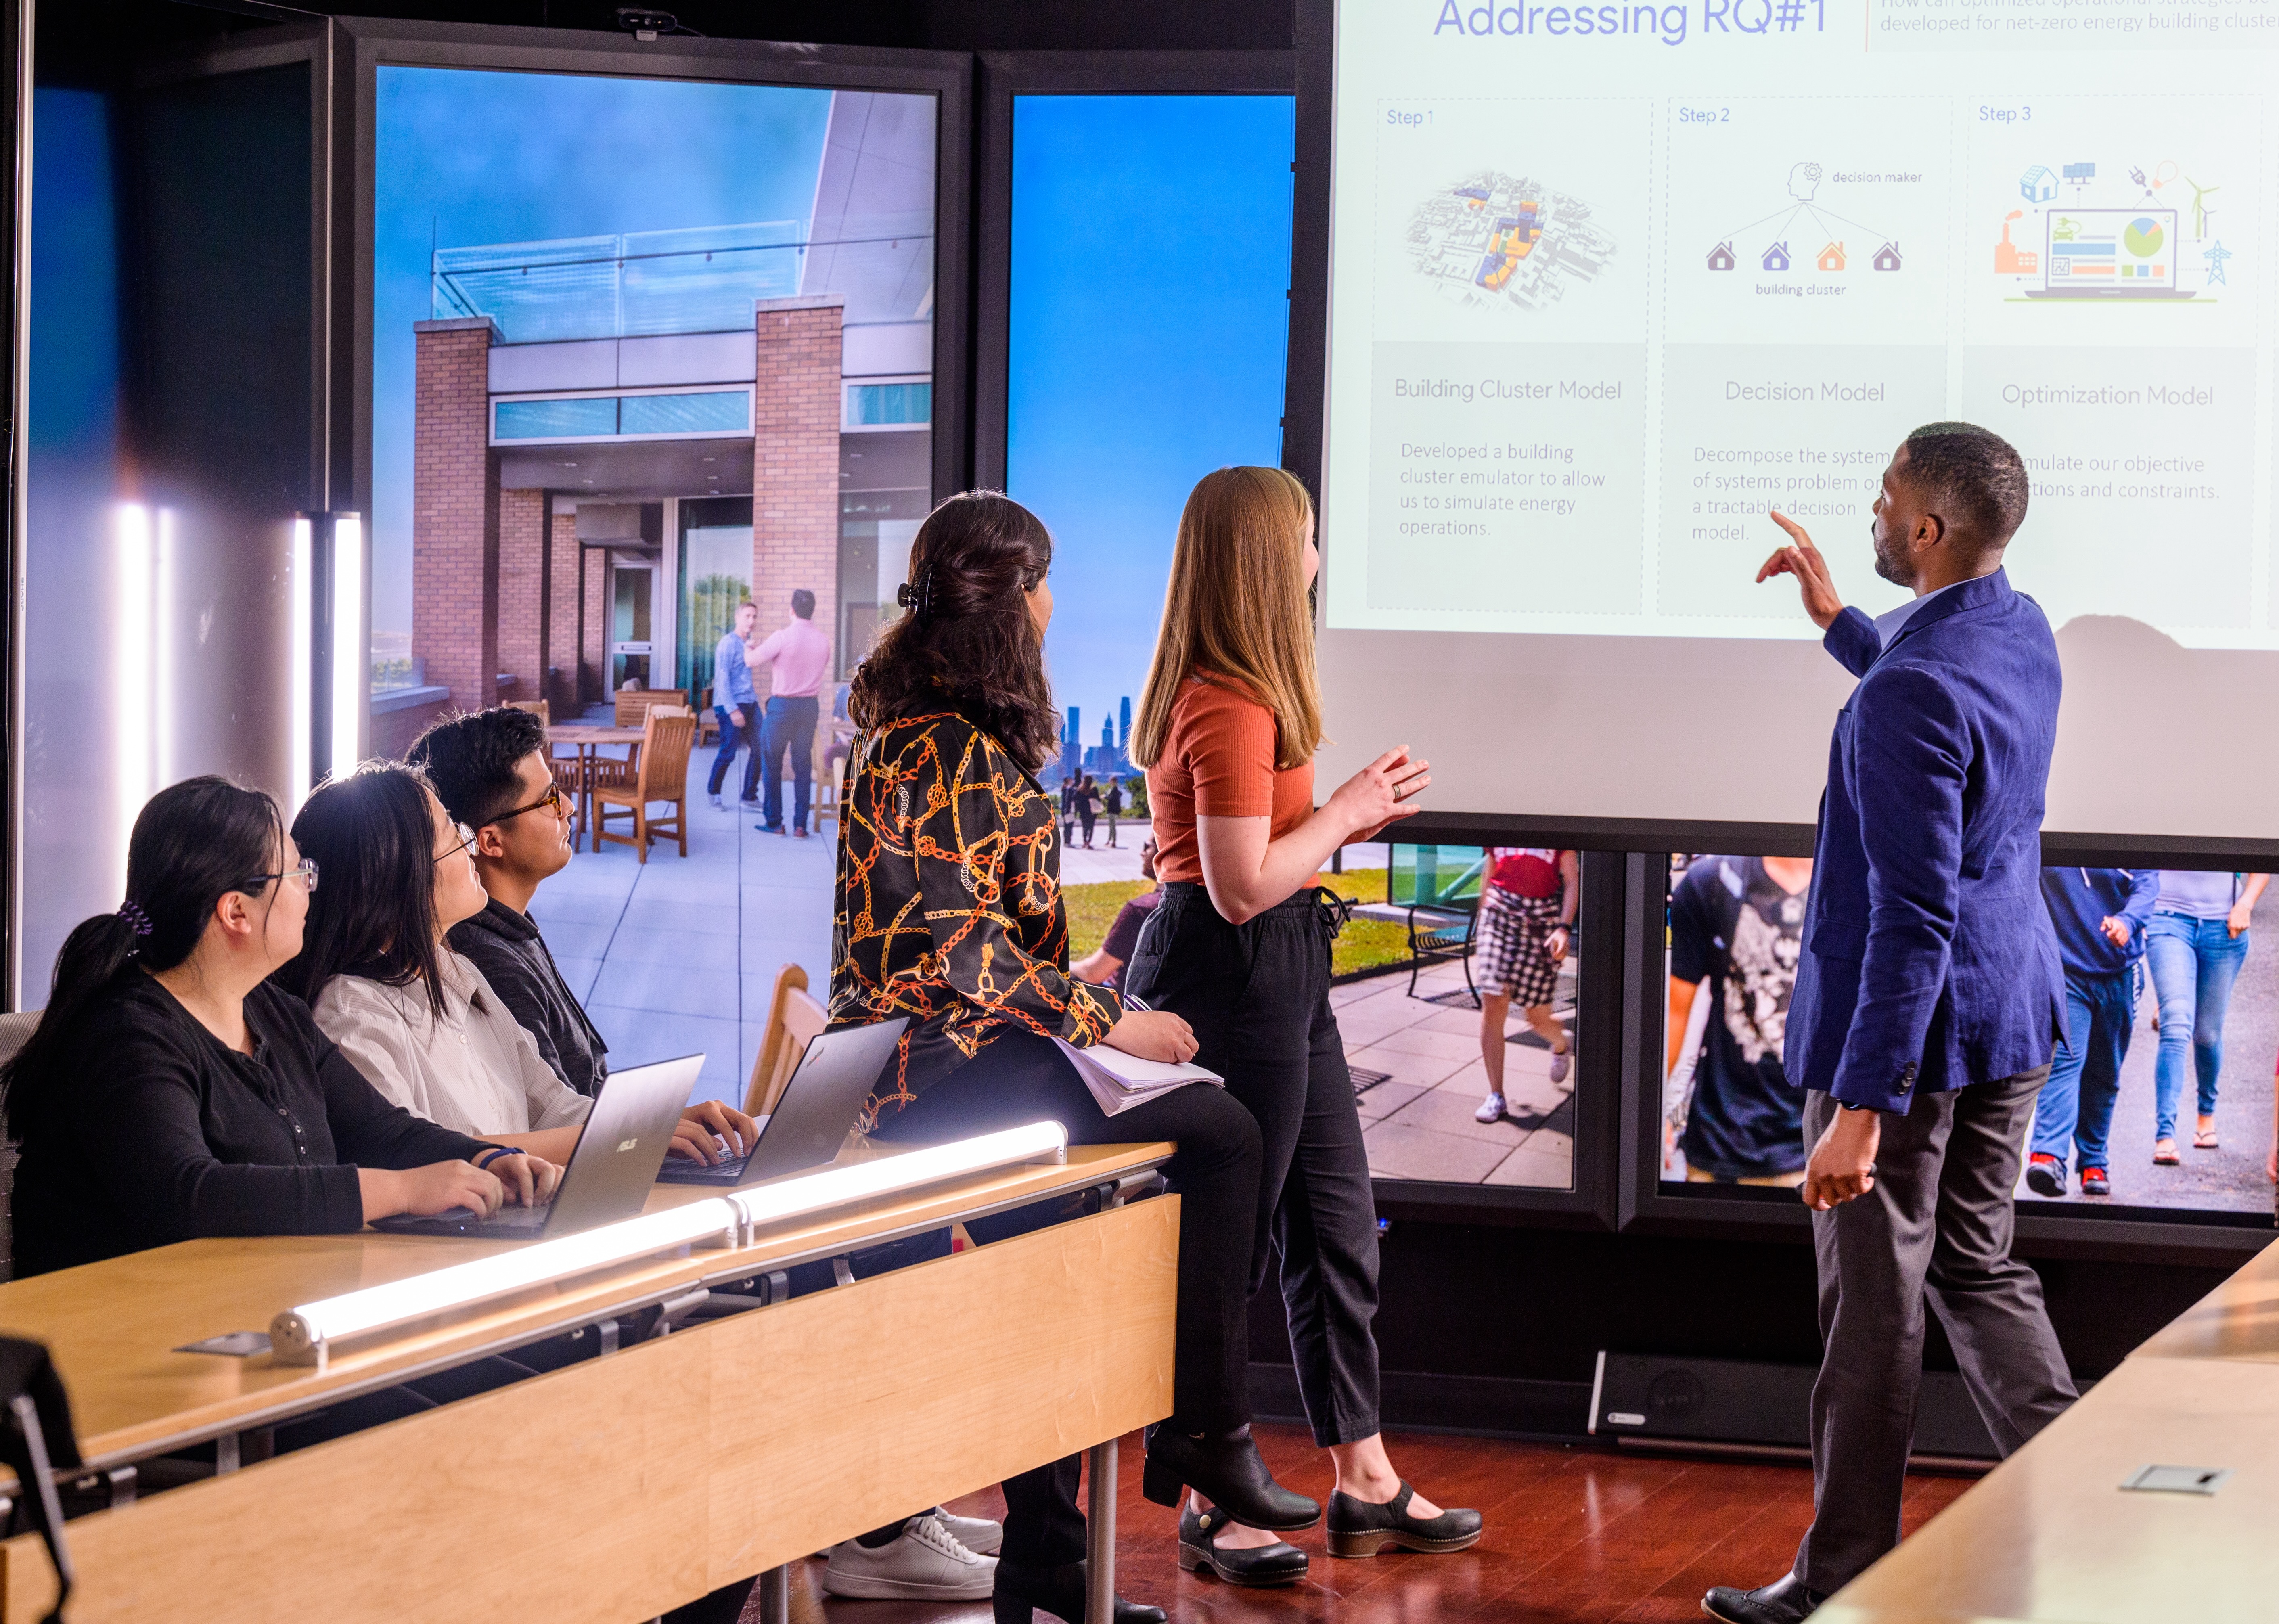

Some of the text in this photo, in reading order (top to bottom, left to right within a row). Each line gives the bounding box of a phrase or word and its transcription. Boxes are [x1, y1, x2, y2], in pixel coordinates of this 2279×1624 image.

[1434, 0, 1824, 46] Addressing RQ#1
[1881, 15, 1969, 33] developed
[1976, 14, 2000, 30] for
[2007, 16, 2077, 30] net-zero
[2084, 18, 2143, 32] energy
[2149, 13, 2219, 31] building
[1387, 109, 1432, 128] Step 1
[1680, 107, 1729, 126] Step 2
[1980, 106, 2031, 124] Step 3
[1833, 172, 1922, 182] decision maker
[1756, 284, 1846, 297] building cluster
[1396, 379, 1621, 403] Building Cluster Model
[1726, 381, 1884, 401] Decision Model
[2003, 384, 2213, 408] Optimization Model
[1402, 442, 1573, 464] Developed a building
[1695, 447, 1890, 467] Decompose the system
[2024, 454, 2204, 475] mulate our objective
[1400, 468, 1605, 486] cluster emulator to allow
[1693, 472, 1710, 488] of
[1716, 475, 1781, 491] systems
[1787, 473, 1857, 492] problem
[2028, 481, 2219, 498] tions and constraints.
[1401, 495, 1576, 515] us to simulate energy
[1693, 498, 1856, 516] a tractable decision
[1400, 520, 1490, 536] operations.
[1693, 524, 1749, 540] model.
